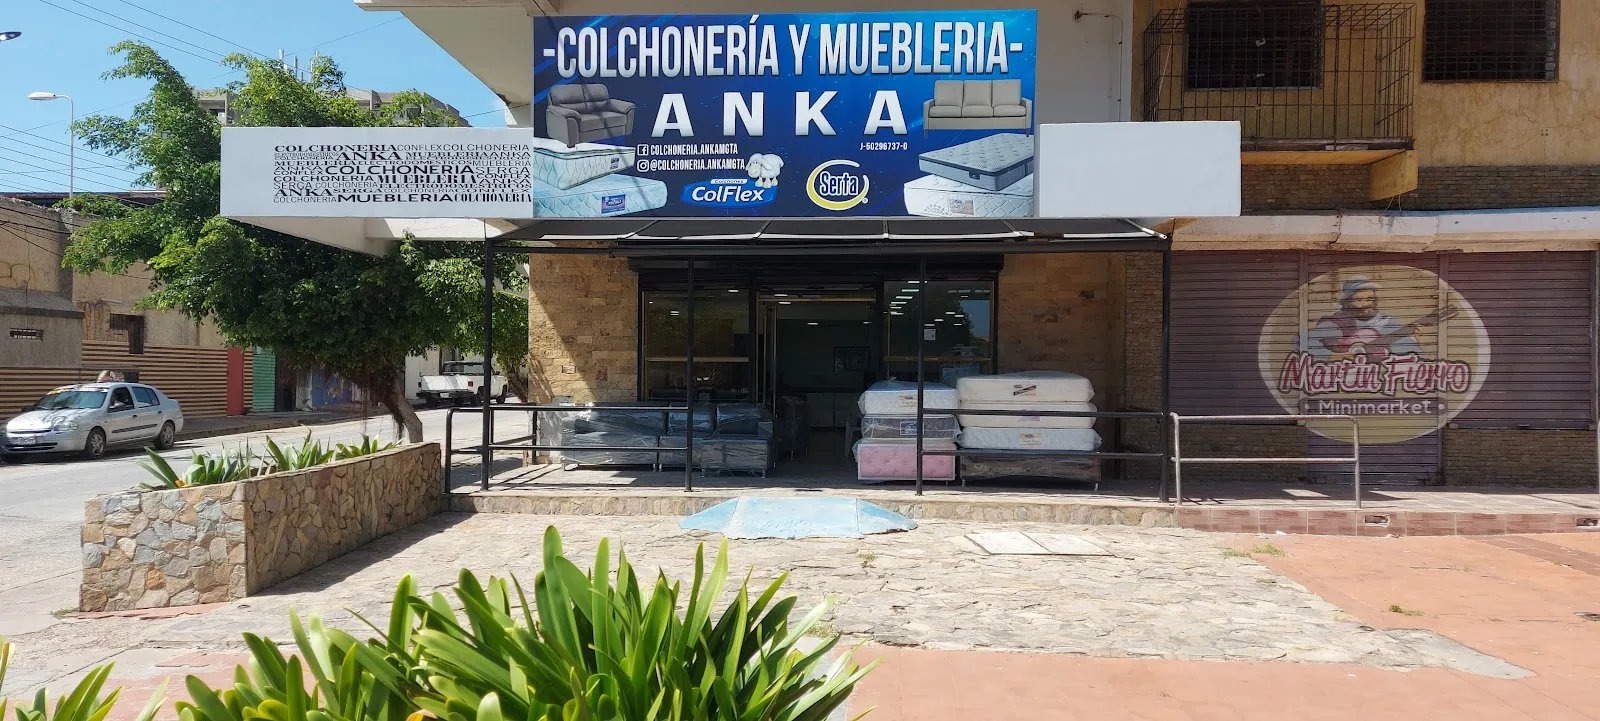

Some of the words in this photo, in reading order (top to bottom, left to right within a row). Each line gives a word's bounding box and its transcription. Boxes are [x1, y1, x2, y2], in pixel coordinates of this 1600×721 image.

[543, 14, 779, 78] -COLCHONERÍA
[788, 24, 811, 75] Y
[819, 21, 1023, 75] MUEBLERIA-
[651, 90, 908, 137] ANKA
[274, 144, 397, 152] COLCHONERIA
[650, 143, 738, 156] COLCHONERIA.ANKAMGTA
[337, 152, 402, 160] ANKA
[325, 165, 475, 174] COLCHONERIA
[650, 158, 745, 171] @COLCHONERIA.ANKAMGTA
[378, 175, 476, 183] MUEBLERIA
[819, 171, 859, 196] Serta
[338, 194, 454, 203] MUEBLERIA
[455, 194, 532, 203] COLCHONERIA
[692, 185, 765, 203] ColFlex
[1280, 352, 1381, 393] Martin
[1384, 353, 1471, 395] Fierro
[1318, 399, 1432, 415] Minimarket
